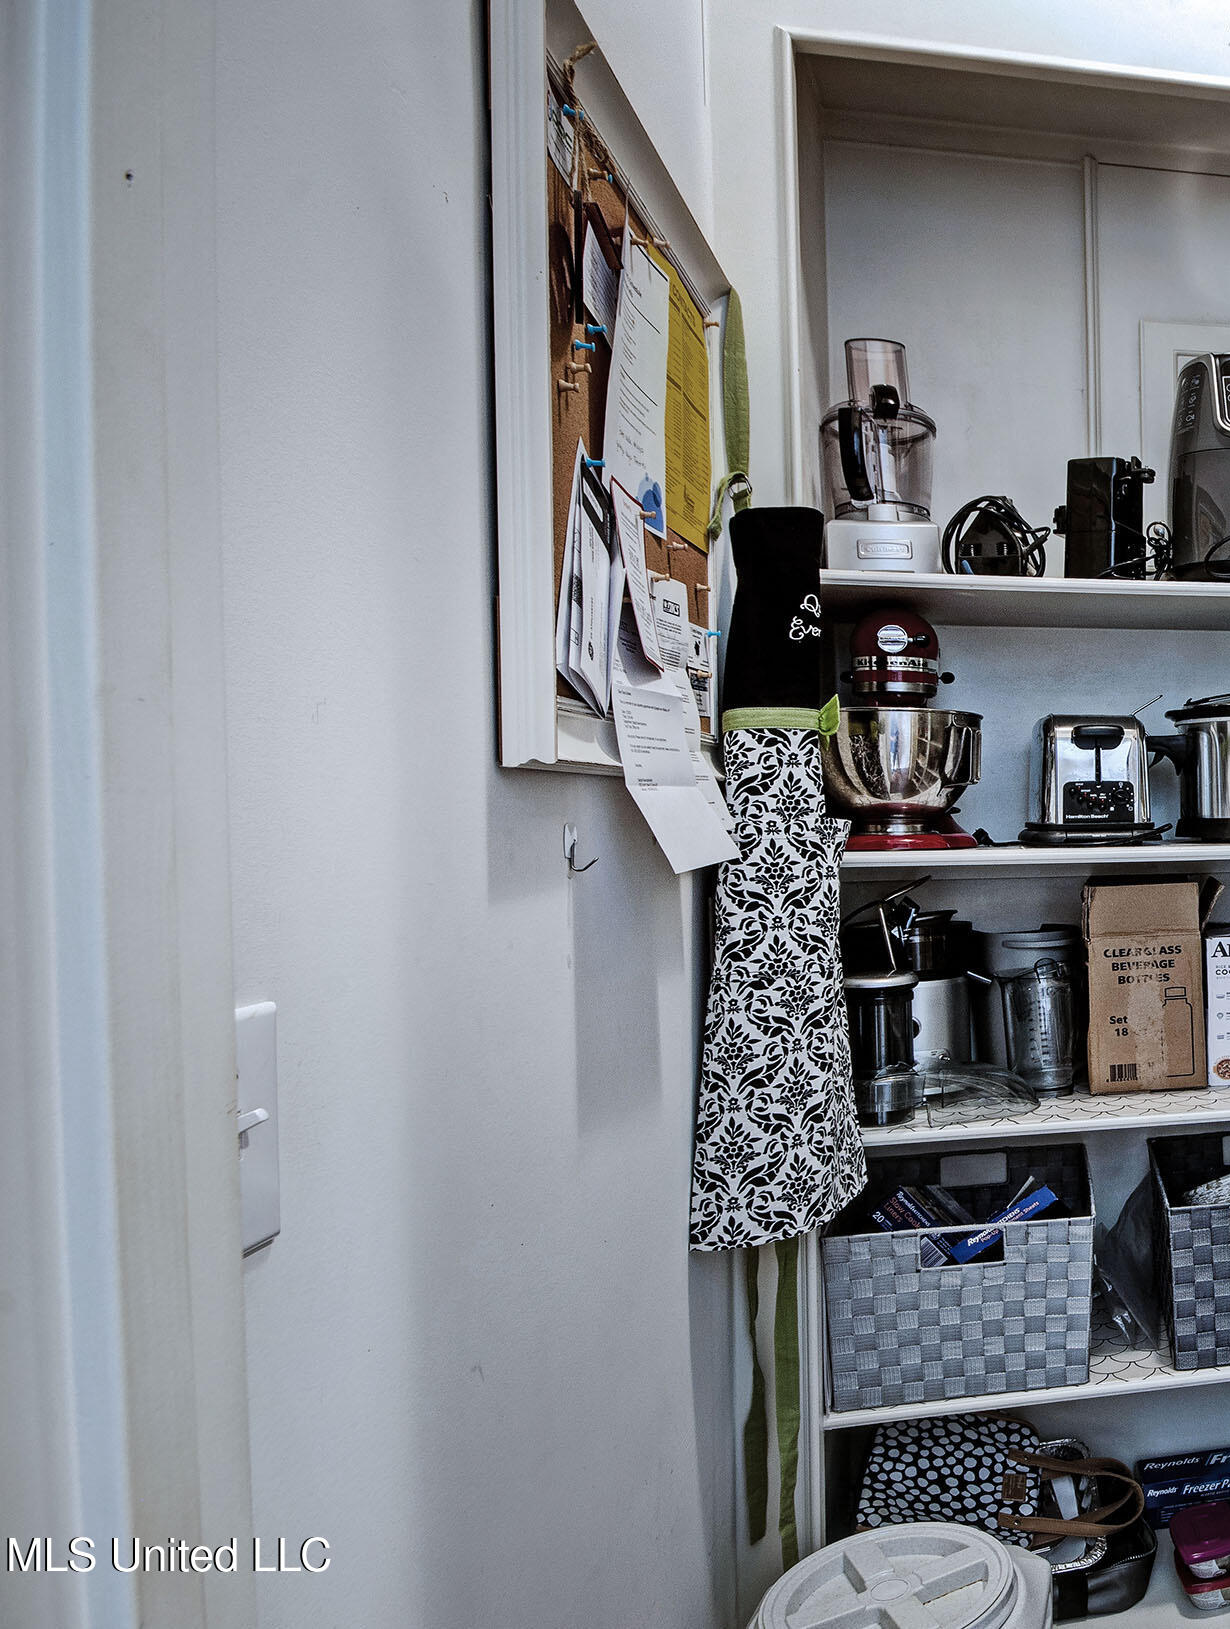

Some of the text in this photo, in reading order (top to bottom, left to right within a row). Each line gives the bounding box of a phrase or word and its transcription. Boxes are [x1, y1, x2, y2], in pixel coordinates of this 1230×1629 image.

[857, 658, 929, 668] KicenAid
[1104, 945, 1182, 958] CLEAR GLASS
[1111, 959, 1175, 972] BEVERAGE
[1117, 973, 1170, 985] BOTTLES
[1109, 1016, 1128, 1025] Set
[1114, 1028, 1129, 1036] 18
[883, 1202, 903, 1223] Liners
[889, 1197, 923, 1230] Slow Cook
[1022, 1200, 1040, 1215] Sheets
[872, 1211, 885, 1224] 20
[1144, 1457, 1200, 1471] Reynolds
[1147, 1486, 1179, 1498] Reynolds
[1182, 1482, 1220, 1495] Freezer
